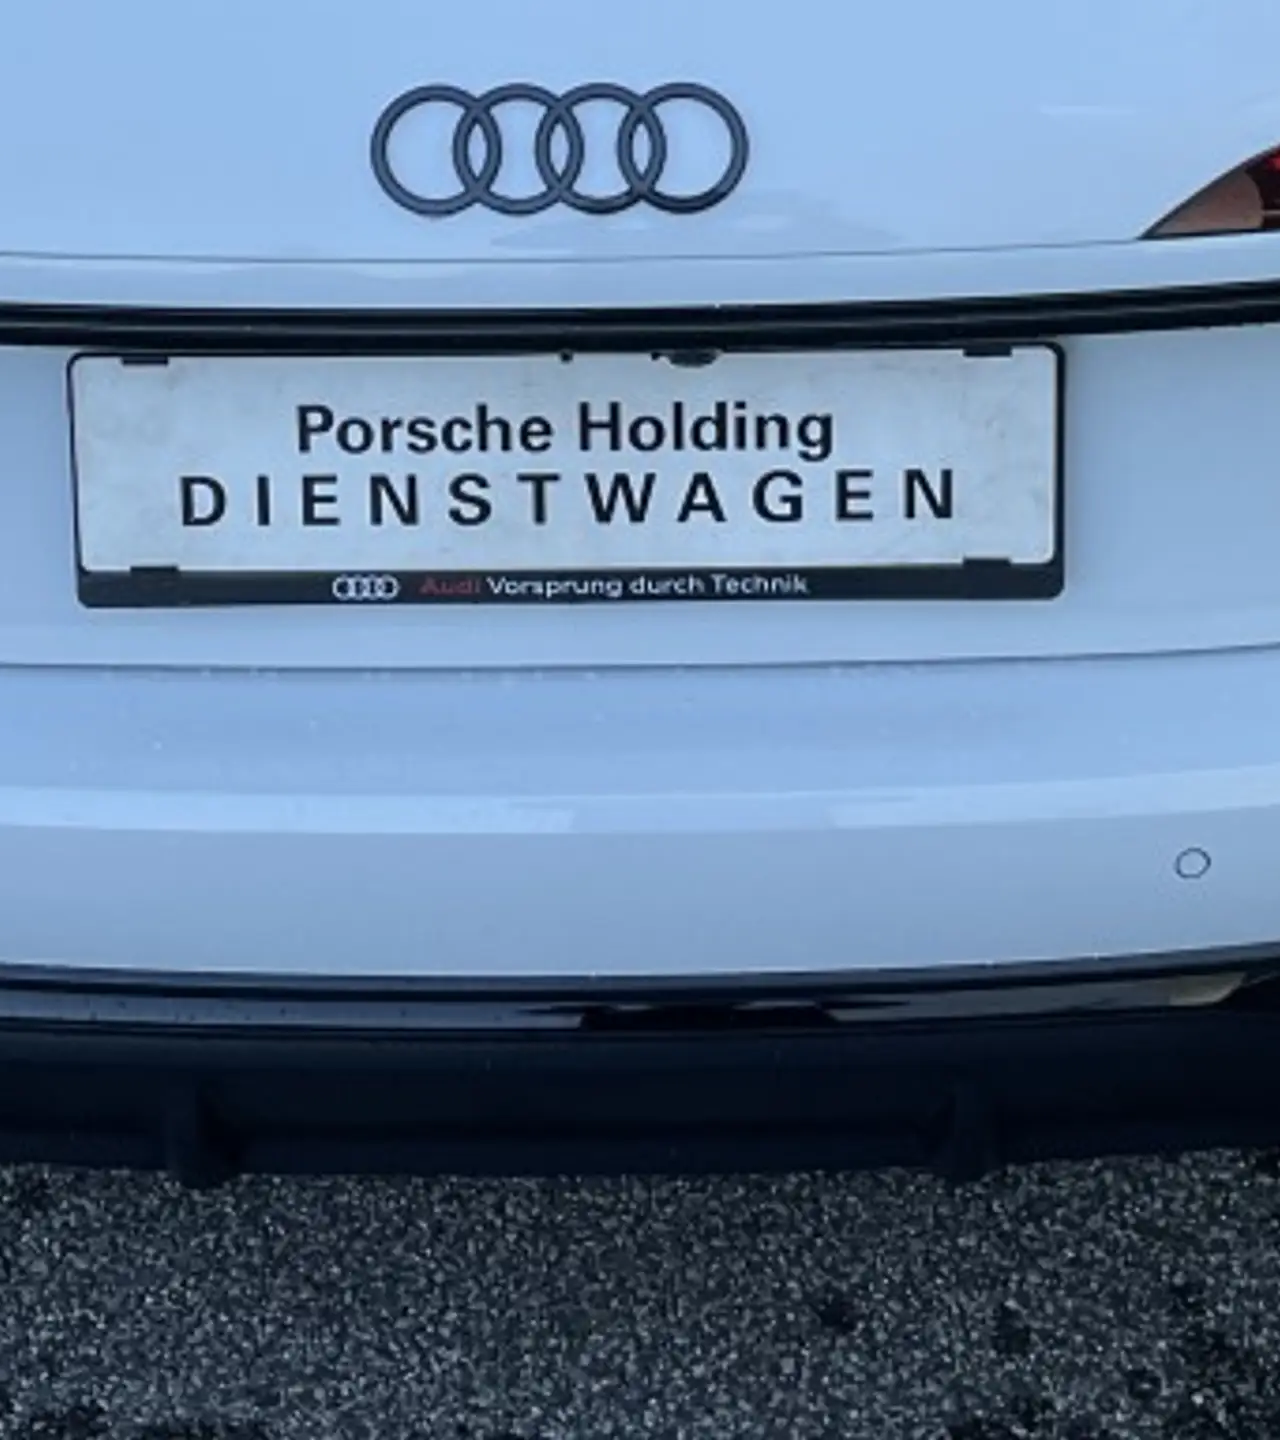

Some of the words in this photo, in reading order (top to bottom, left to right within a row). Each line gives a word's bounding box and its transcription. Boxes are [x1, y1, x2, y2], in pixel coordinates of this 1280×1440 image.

[297, 405, 554, 454] Porsche
[579, 401, 834, 457] Holding
[180, 468, 954, 527] DIENSTWAGEN
[421, 575, 481, 594] Audi
[486, 577, 623, 598] Vorsprung
[629, 575, 706, 593] durch
[711, 573, 808, 594] Technik
